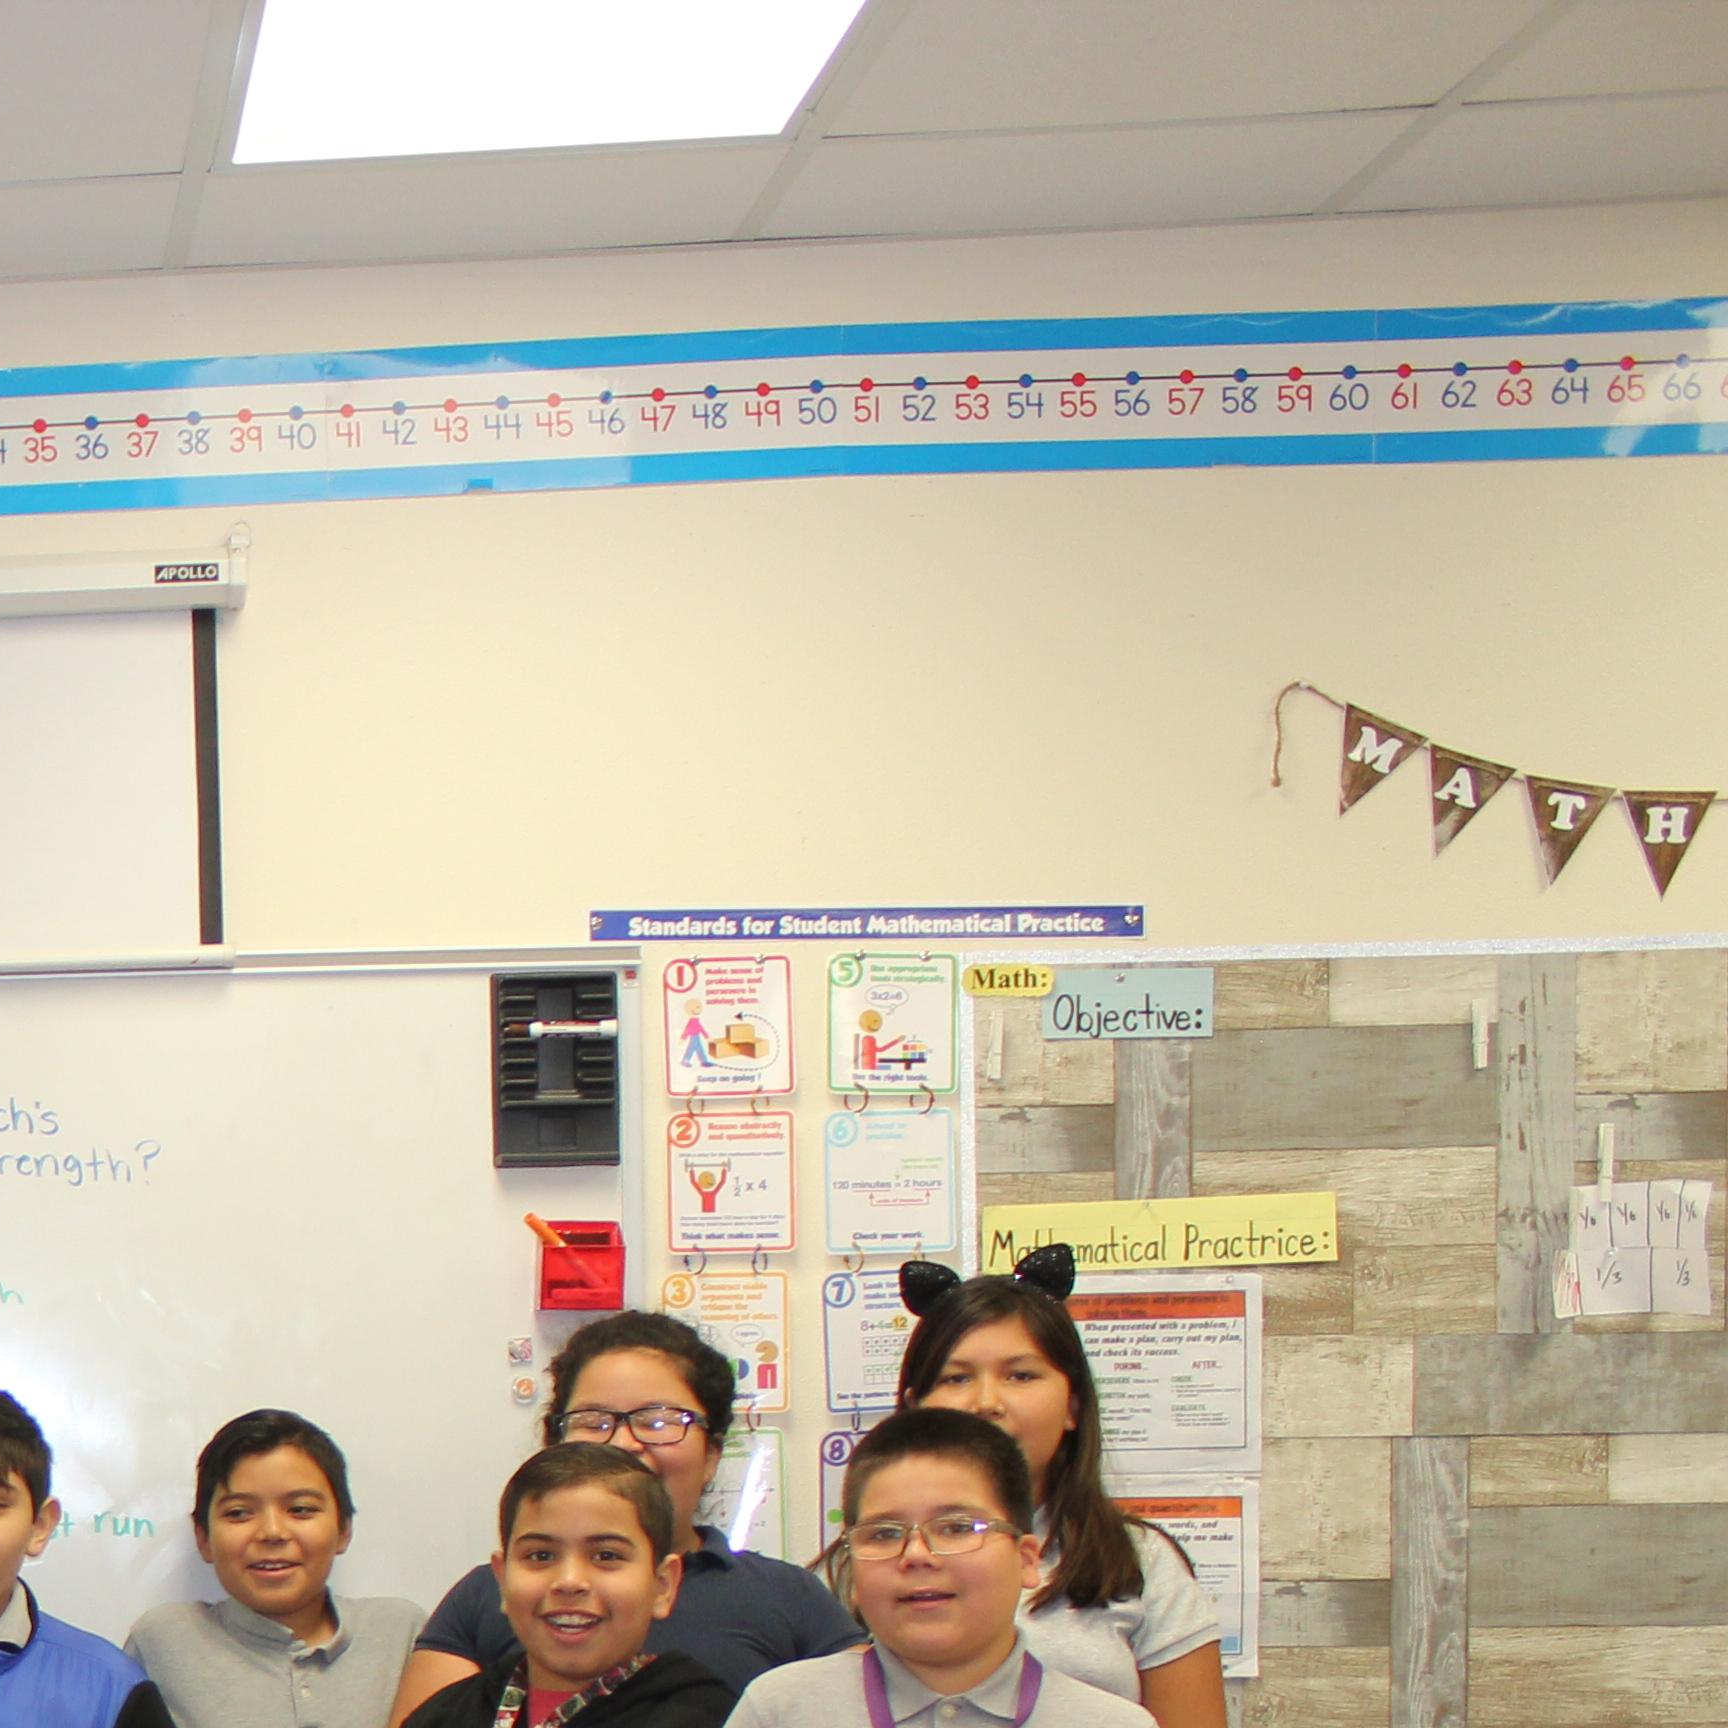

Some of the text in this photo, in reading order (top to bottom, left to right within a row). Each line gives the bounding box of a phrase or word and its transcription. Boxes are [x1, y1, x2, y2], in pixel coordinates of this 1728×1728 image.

[278, 423, 316, 450] 40
[745, 400, 780, 426] 49
[1169, 387, 1204, 415] 57
[1663, 373, 1702, 401] 66
[157, 566, 217, 580] APOLLO
[1347, 727, 1688, 844] MATH
[629, 914, 1103, 936] Standards for Student Mathematical Practice
[974, 969, 1046, 988] Math:
[1053, 993, 1203, 1033] Objective:
[852, 1178, 942, 1190] minutes hours
[1184, 1221, 1328, 1261] Practrice:
[87, 1506, 154, 1537] run
